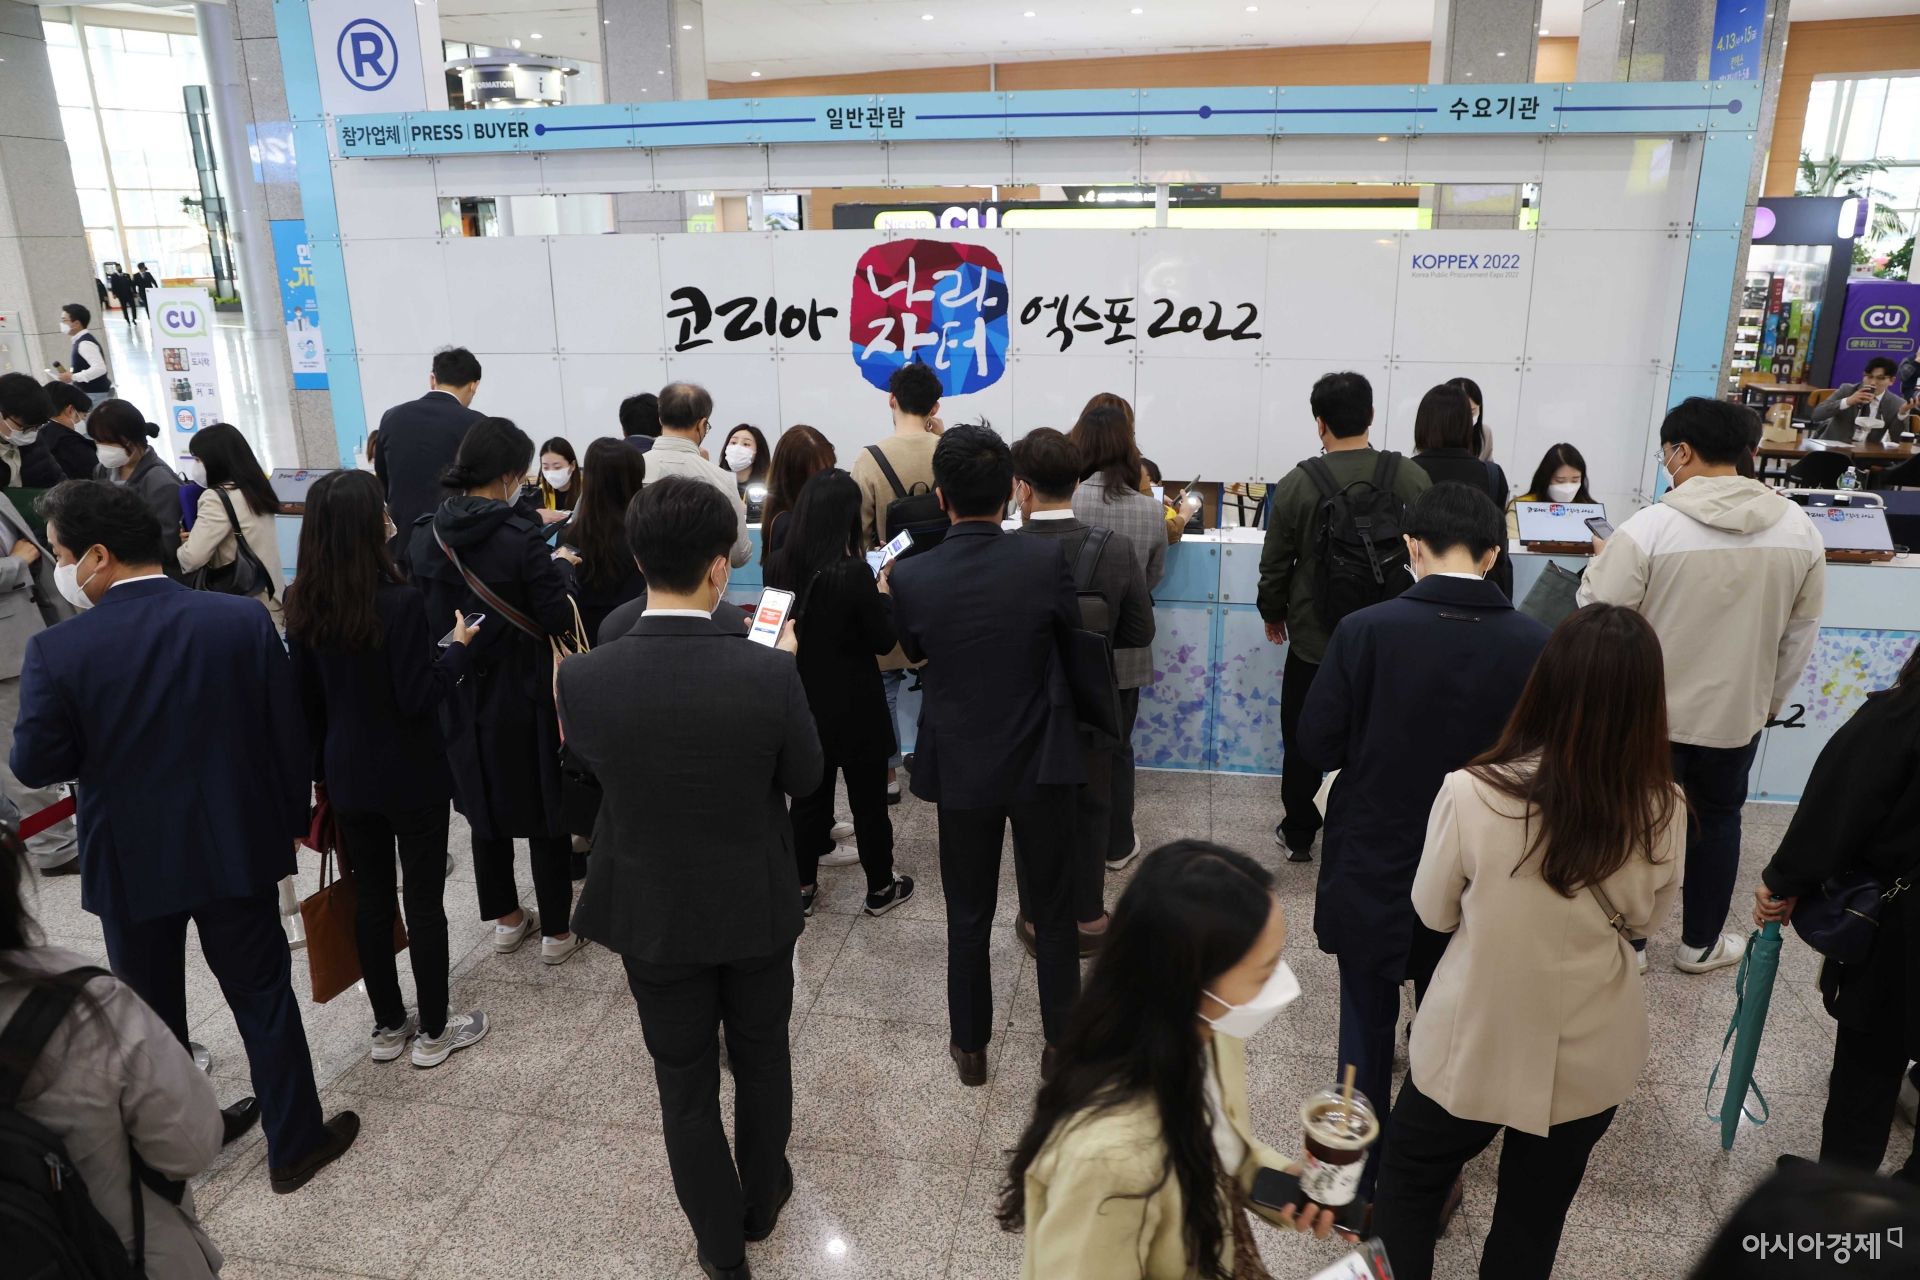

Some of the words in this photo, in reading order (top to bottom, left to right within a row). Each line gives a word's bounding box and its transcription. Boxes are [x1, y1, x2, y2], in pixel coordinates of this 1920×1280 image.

[826, 105, 906, 130] 일반관람
[1449, 96, 1540, 121] 수요기관
[342, 125, 401, 147] 참가업체
[411, 124, 463, 142] PRESS
[473, 122, 530, 139] BUYER
[1412, 254, 1479, 269] KOPPEX
[1483, 254, 1521, 269] 2022
[866, 256, 998, 312] 나라
[166, 310, 196, 329] CU
[666, 286, 839, 353] 코리아
[1020, 294, 1137, 352] 엑스포
[1147, 298, 1262, 341] 2022
[1869, 311, 1901, 326] CU
